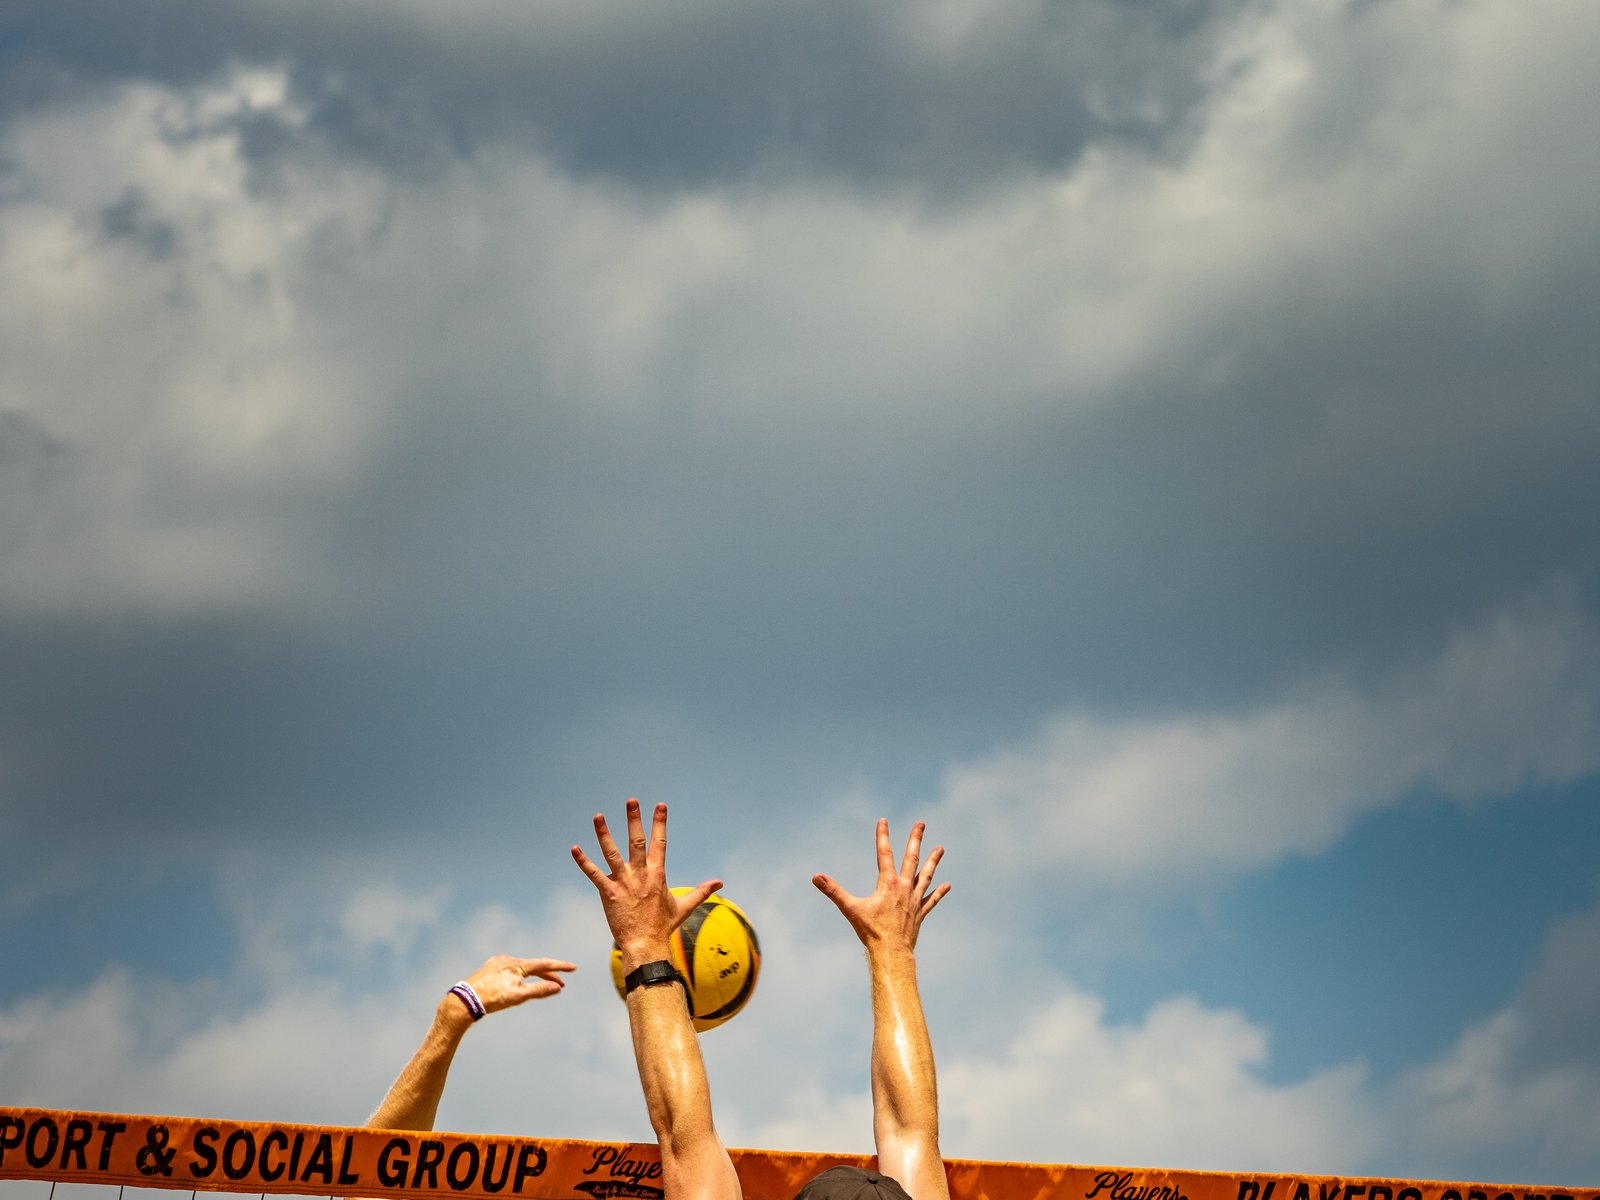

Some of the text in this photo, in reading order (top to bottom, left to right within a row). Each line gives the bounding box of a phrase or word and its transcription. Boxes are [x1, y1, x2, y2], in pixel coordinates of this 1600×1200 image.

[136, 1124, 177, 1177] &
[189, 1127, 359, 1186] SOCIAL
[377, 1138, 548, 1194] GROUP
[582, 1146, 663, 1185] Playe
